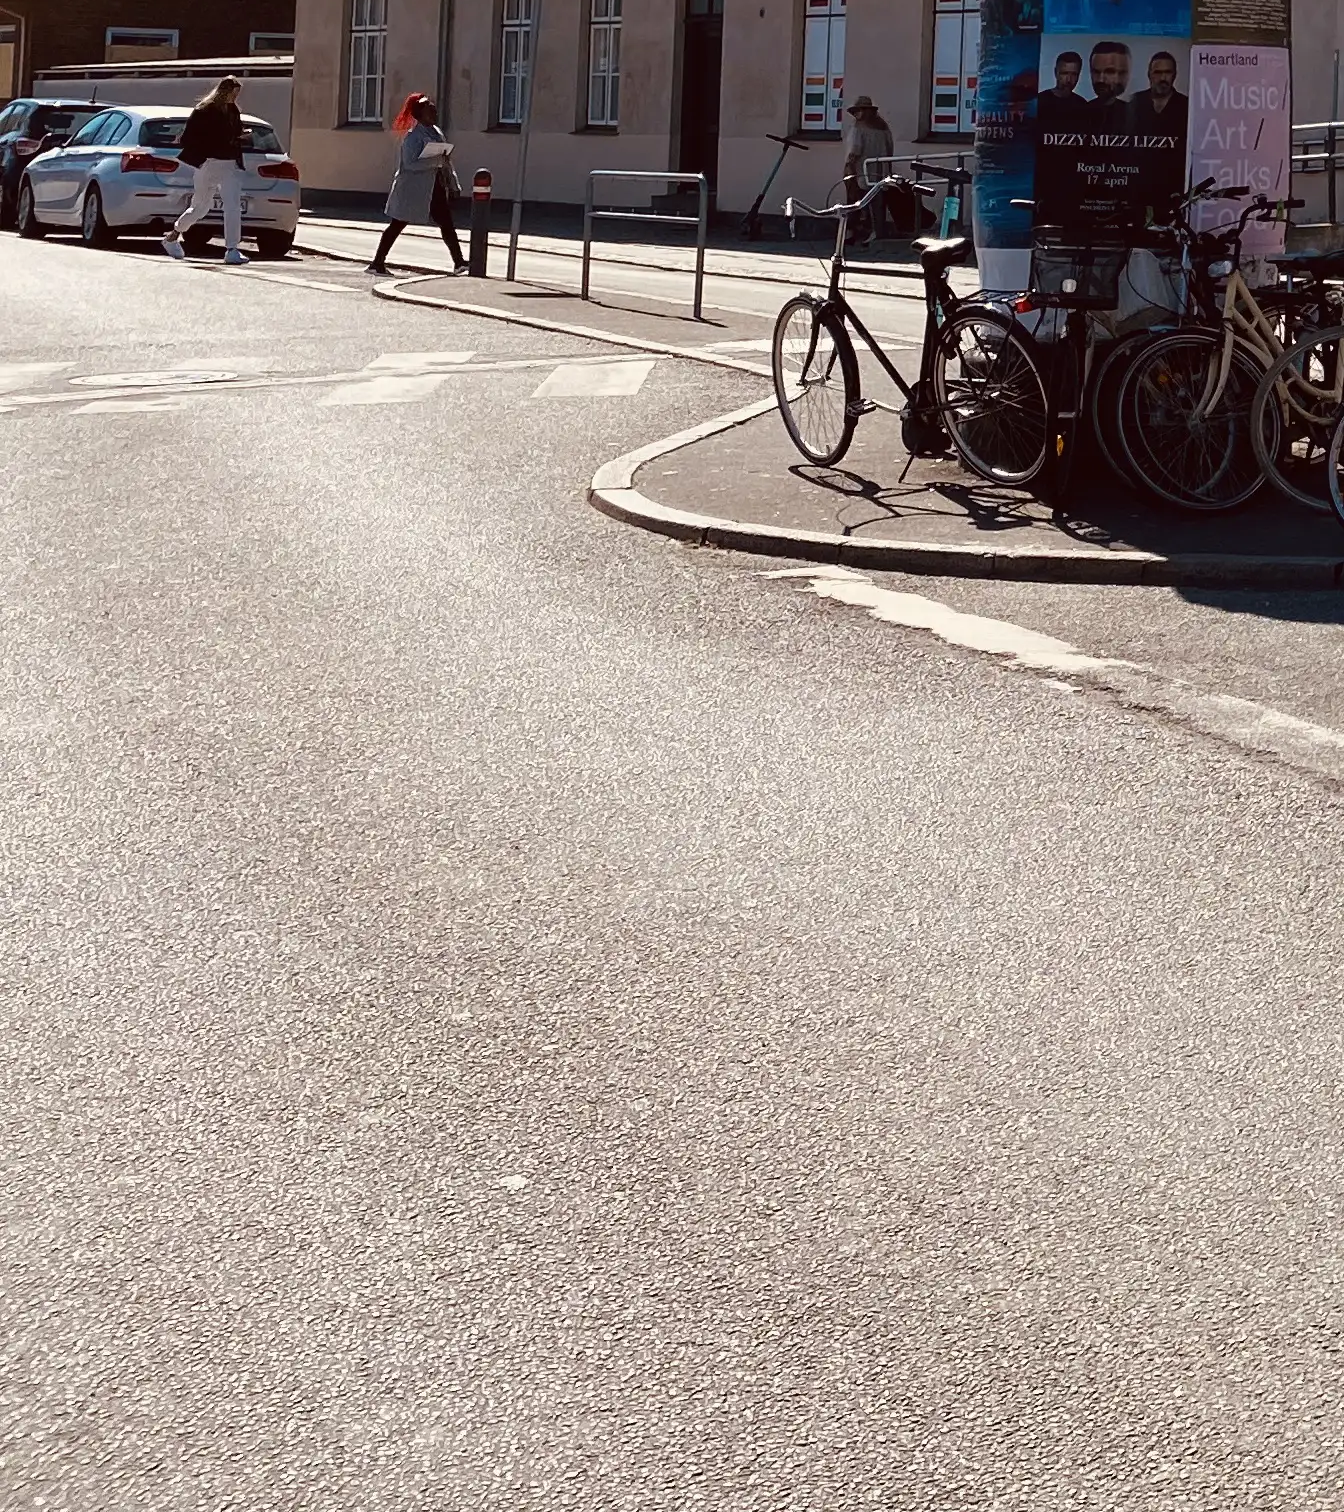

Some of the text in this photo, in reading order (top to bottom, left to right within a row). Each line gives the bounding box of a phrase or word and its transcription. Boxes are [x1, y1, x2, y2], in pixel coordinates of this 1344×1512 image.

[1199, 53, 1258, 66] Heartland
[1043, 133, 1179, 148] DIZZY MIZZ LIZZY
[1077, 162, 1140, 175] Royal Arena
[1087, 175, 1129, 188] 17 april
